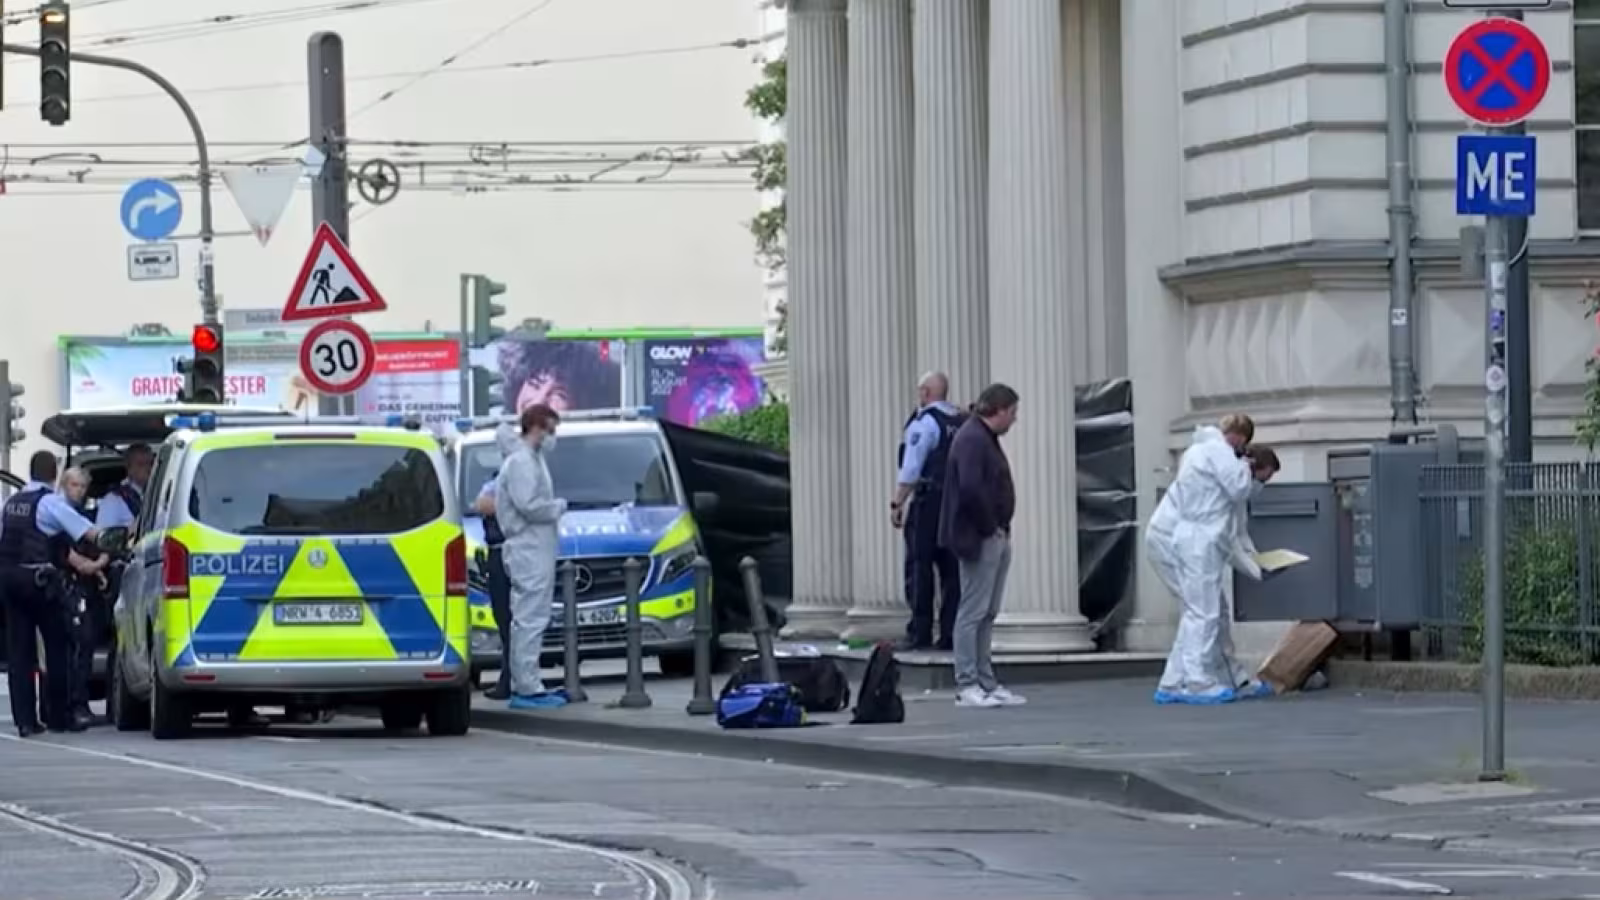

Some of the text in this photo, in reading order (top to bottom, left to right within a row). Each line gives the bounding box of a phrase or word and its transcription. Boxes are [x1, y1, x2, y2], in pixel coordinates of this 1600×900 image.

[1466, 151, 1526, 201] ME
[315, 339, 358, 376] 30
[650, 346, 693, 360] GLOW
[132, 376, 182, 396] GRATIS
[378, 404, 401, 412] DAS
[192, 554, 284, 574] POLIZEI
